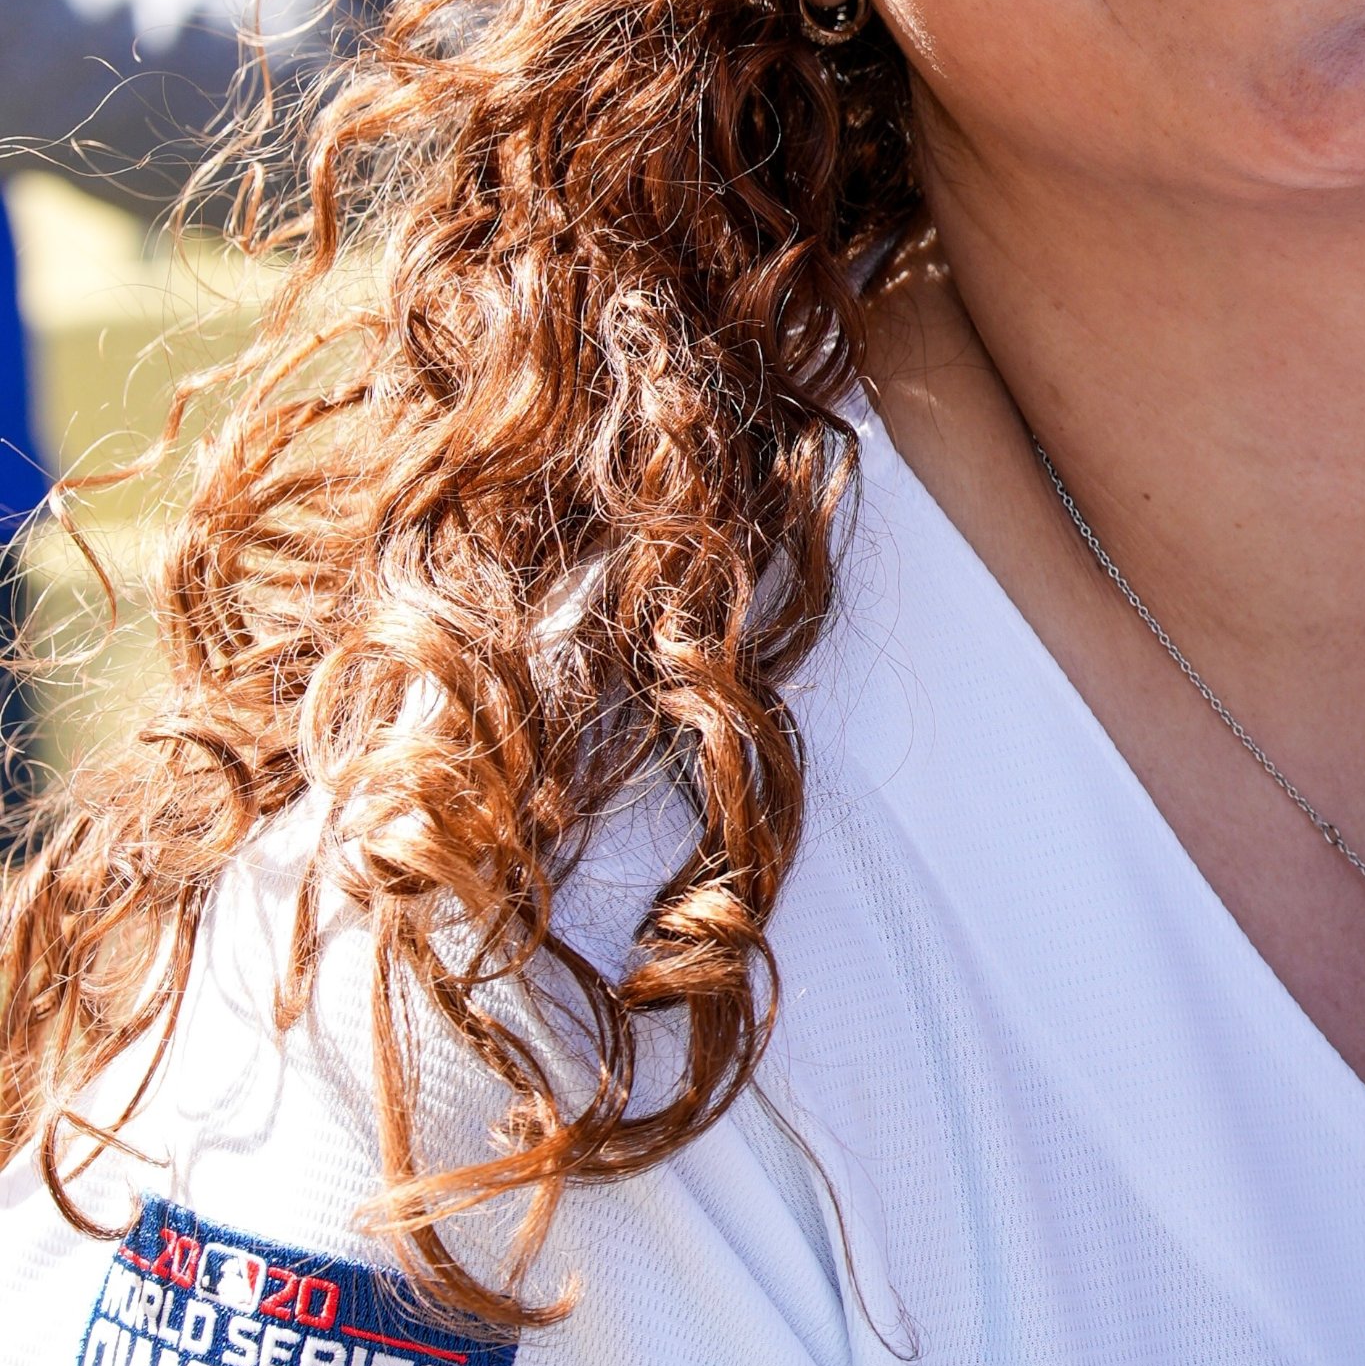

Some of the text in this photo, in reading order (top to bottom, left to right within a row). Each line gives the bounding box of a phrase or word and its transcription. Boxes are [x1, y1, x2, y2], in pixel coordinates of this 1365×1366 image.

[103, 1262, 217, 1354] WORLD
[153, 1229, 341, 1330] 20 20
